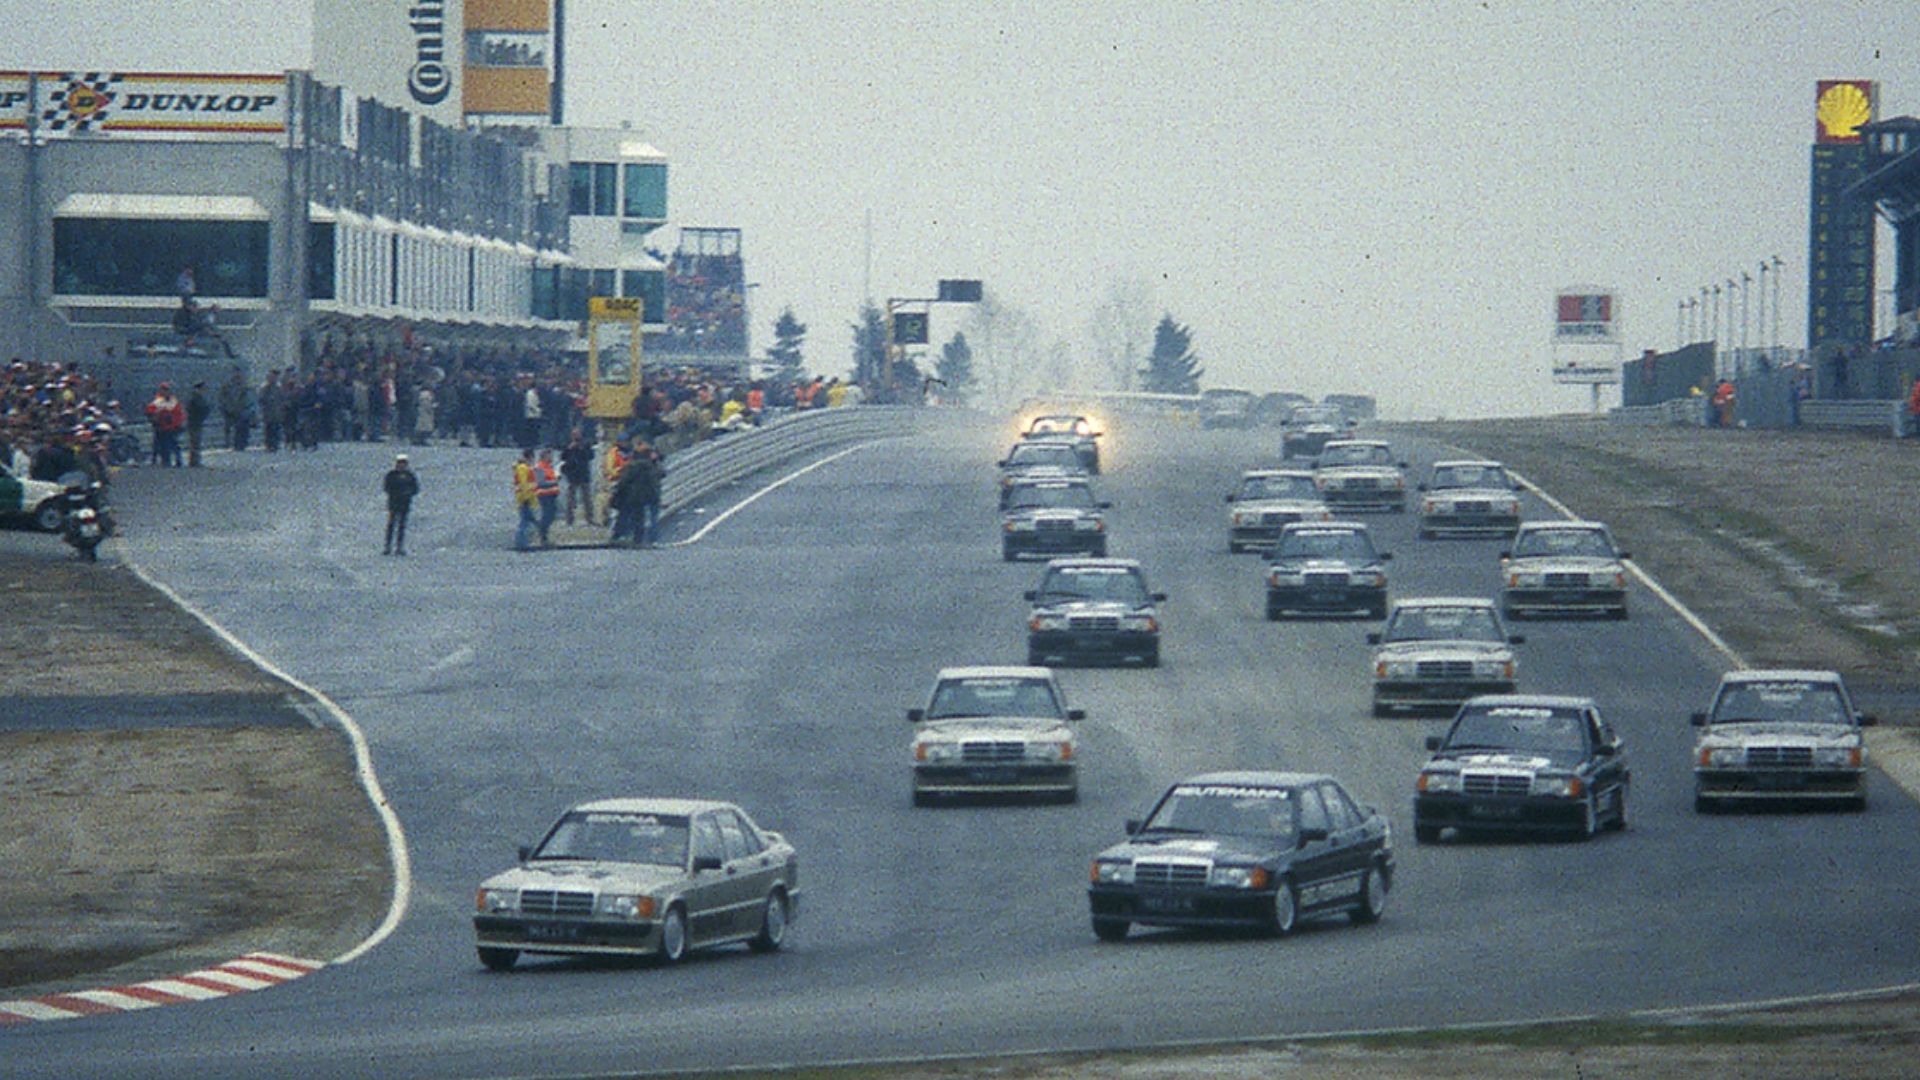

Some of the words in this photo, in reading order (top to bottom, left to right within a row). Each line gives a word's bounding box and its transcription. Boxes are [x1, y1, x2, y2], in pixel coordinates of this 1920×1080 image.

[408, 0, 451, 105] Conti
[0, 92, 28, 107] P
[121, 94, 277, 112] DUNLOP
